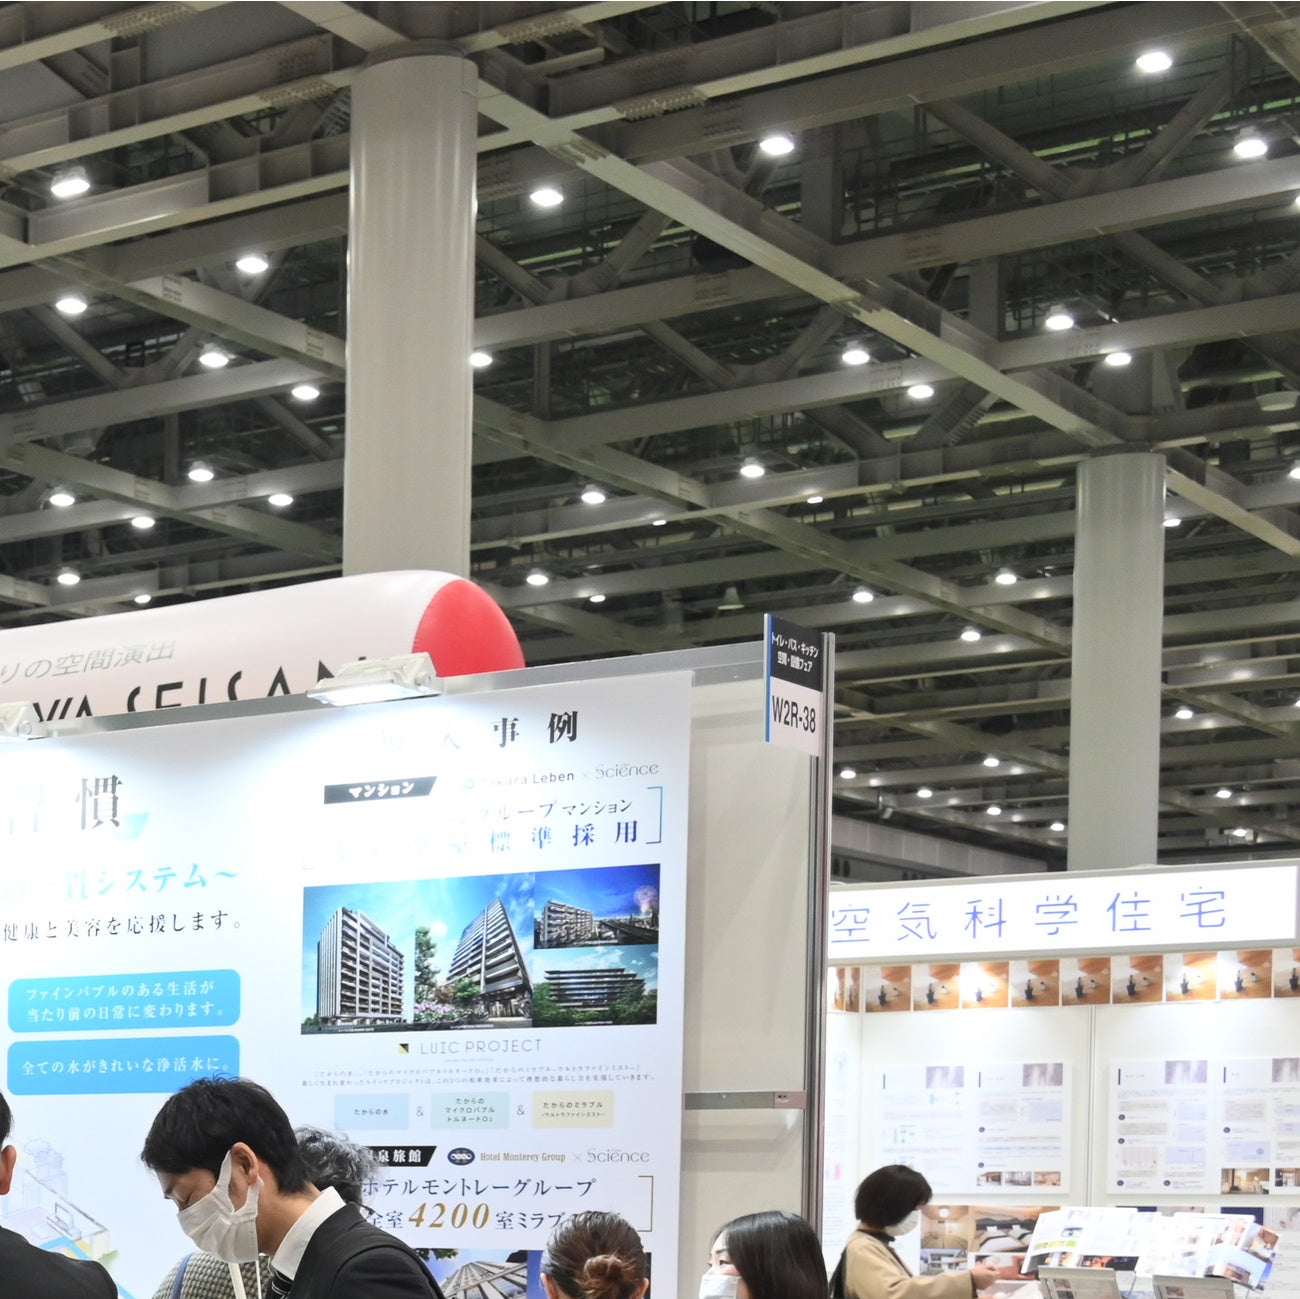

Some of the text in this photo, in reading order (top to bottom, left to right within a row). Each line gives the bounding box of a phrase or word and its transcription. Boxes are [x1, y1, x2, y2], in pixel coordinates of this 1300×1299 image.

[771, 695, 817, 734] W2R-38
[531, 771, 575, 785] Leben
[830, 887, 1227, 944] 空気科学住宅
[26, 980, 215, 1001] ファインバブルのある生活が
[26, 1002, 224, 1024] 当たり前の日常に変わります。
[420, 1039, 542, 1055] LUIC PROJECT
[22, 1056, 229, 1076] 全ての水がきれいな浄活水に。
[371, 1149, 423, 1163] 泉旅館
[480, 1148, 650, 1164] Hotel Monterey Group Science
[362, 1177, 597, 1198] ホテルモントレーグループ
